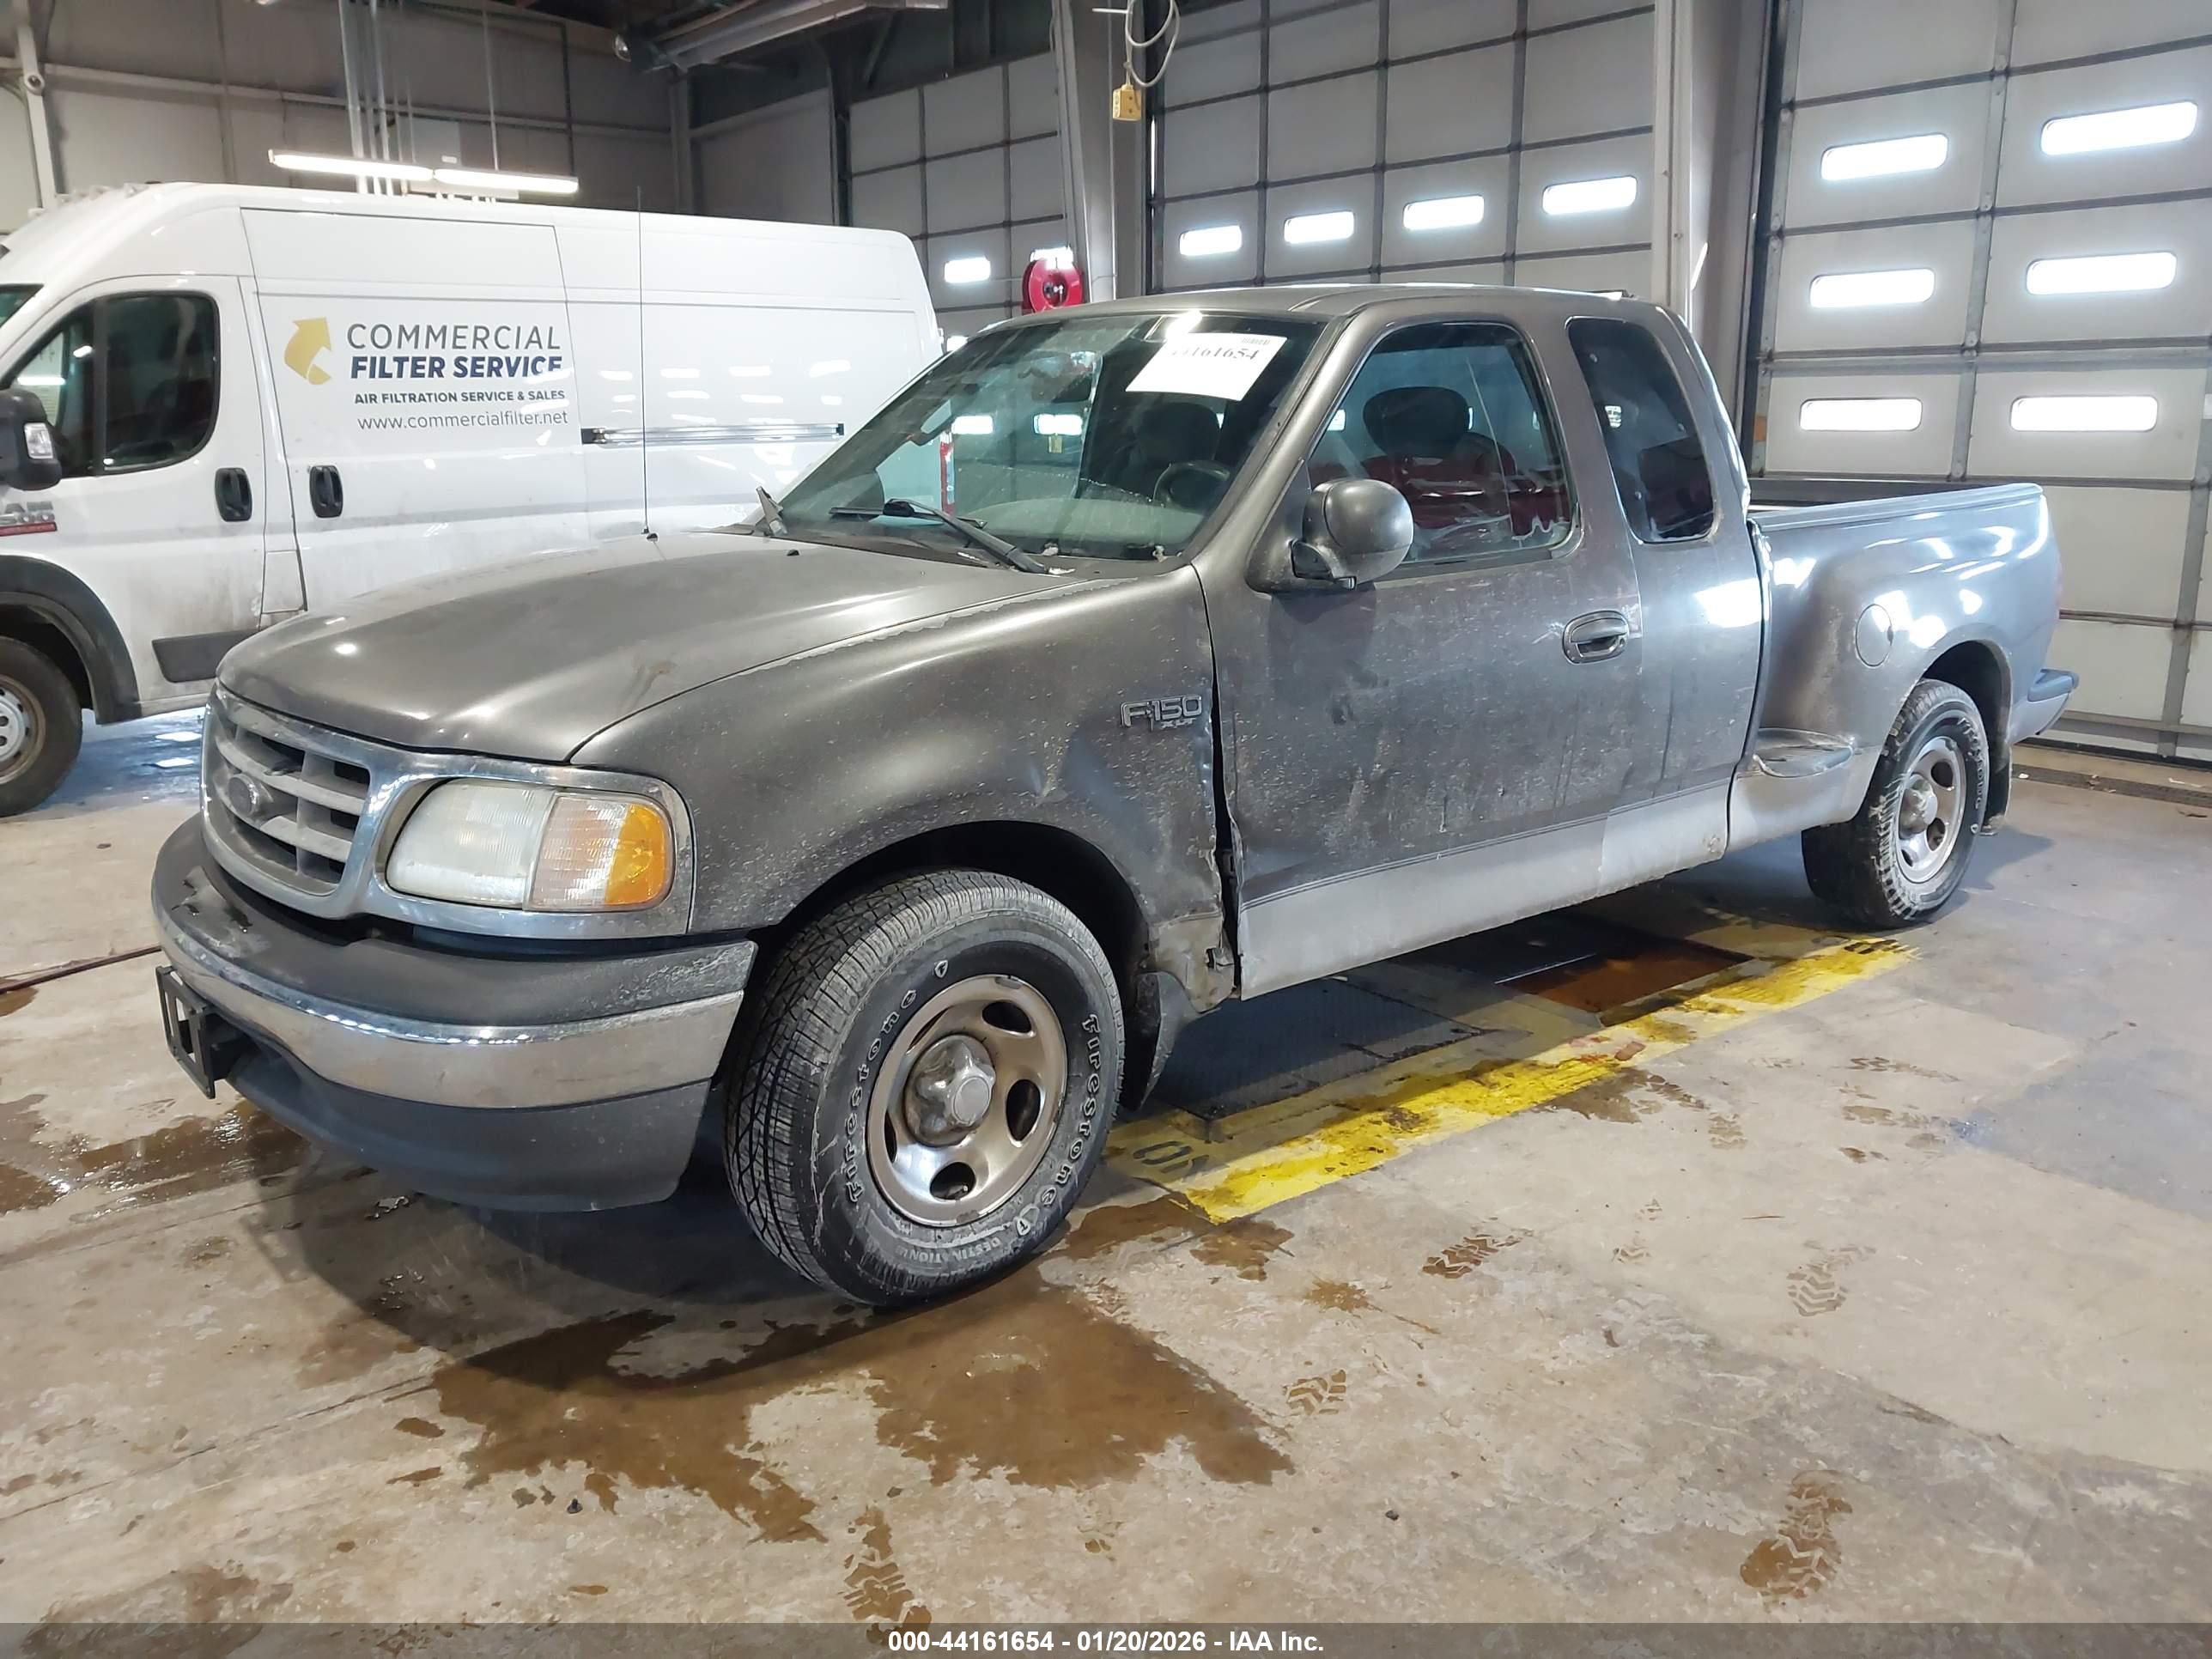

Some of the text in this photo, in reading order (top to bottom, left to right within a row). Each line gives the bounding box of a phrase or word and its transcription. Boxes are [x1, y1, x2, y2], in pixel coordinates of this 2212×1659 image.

[346, 323, 561, 350] COMMERCIAL
[1171, 347, 1260, 361] 161654
[350, 356, 563, 380] FILTER SERVICE
[354, 389, 566, 404] AIR FILTRATION SERVICE & SALES
[357, 410, 568, 430] www.commercialfilter.net
[842, 988, 917, 1206] Firestone
[1036, 1012, 1101, 1207] Firestone
